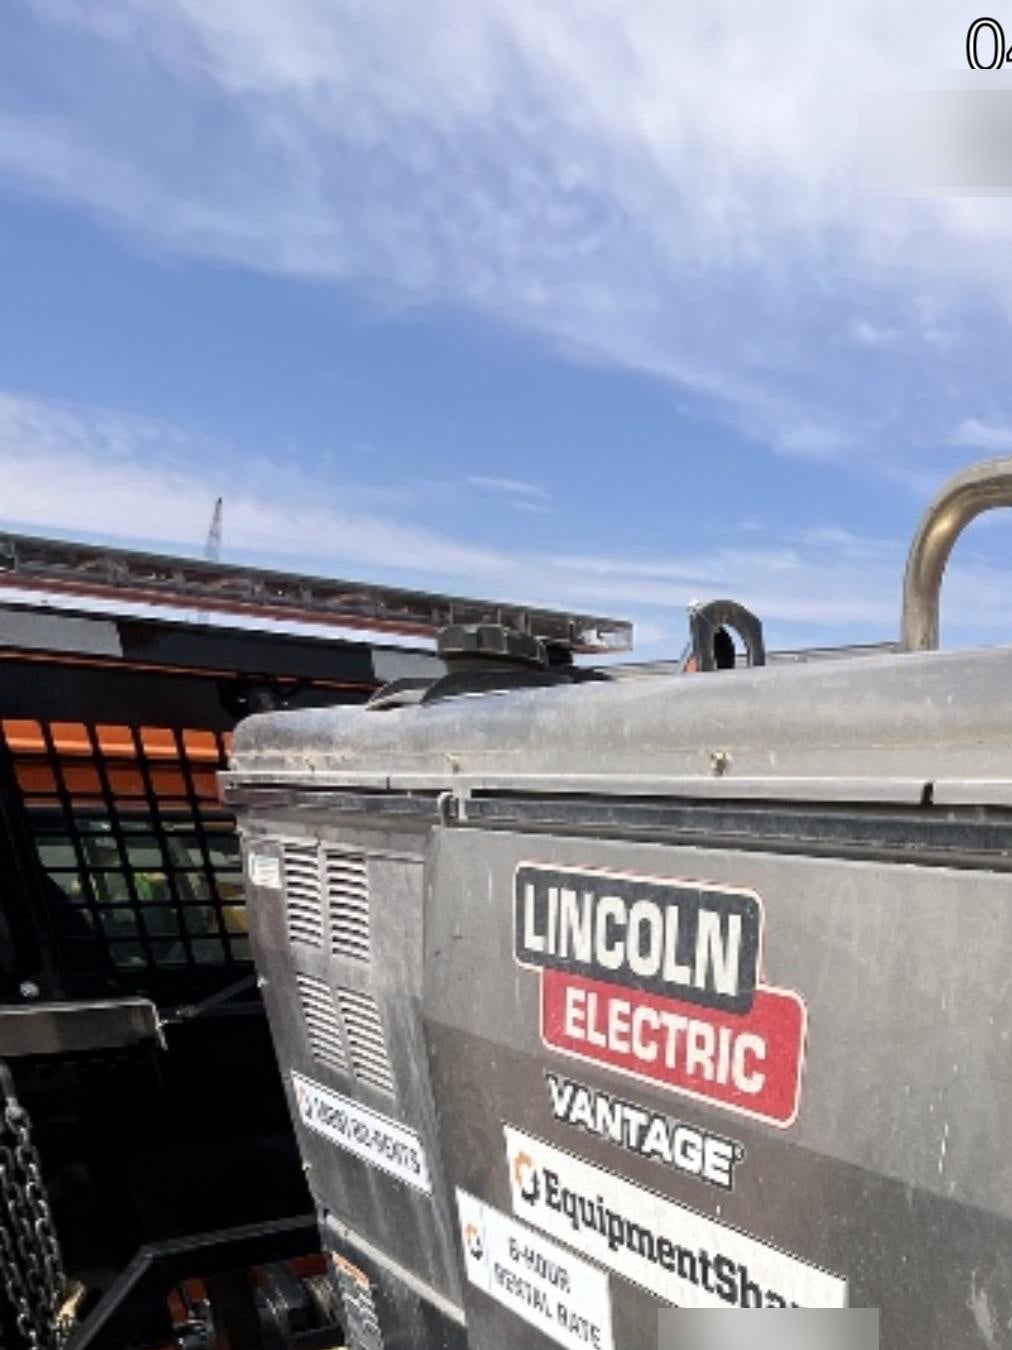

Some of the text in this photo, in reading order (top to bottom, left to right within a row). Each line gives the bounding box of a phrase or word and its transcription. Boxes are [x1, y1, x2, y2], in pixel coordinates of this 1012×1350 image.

[523, 883, 742, 997] LINCOLN
[564, 986, 766, 1094] ELECTRIC
[547, 1075, 735, 1188] VANTAGE
[508, 1236, 571, 1294] 6-HOUR
[542, 1166, 803, 1308] EquipmentSha
[557, 1302, 602, 1350] RATE
